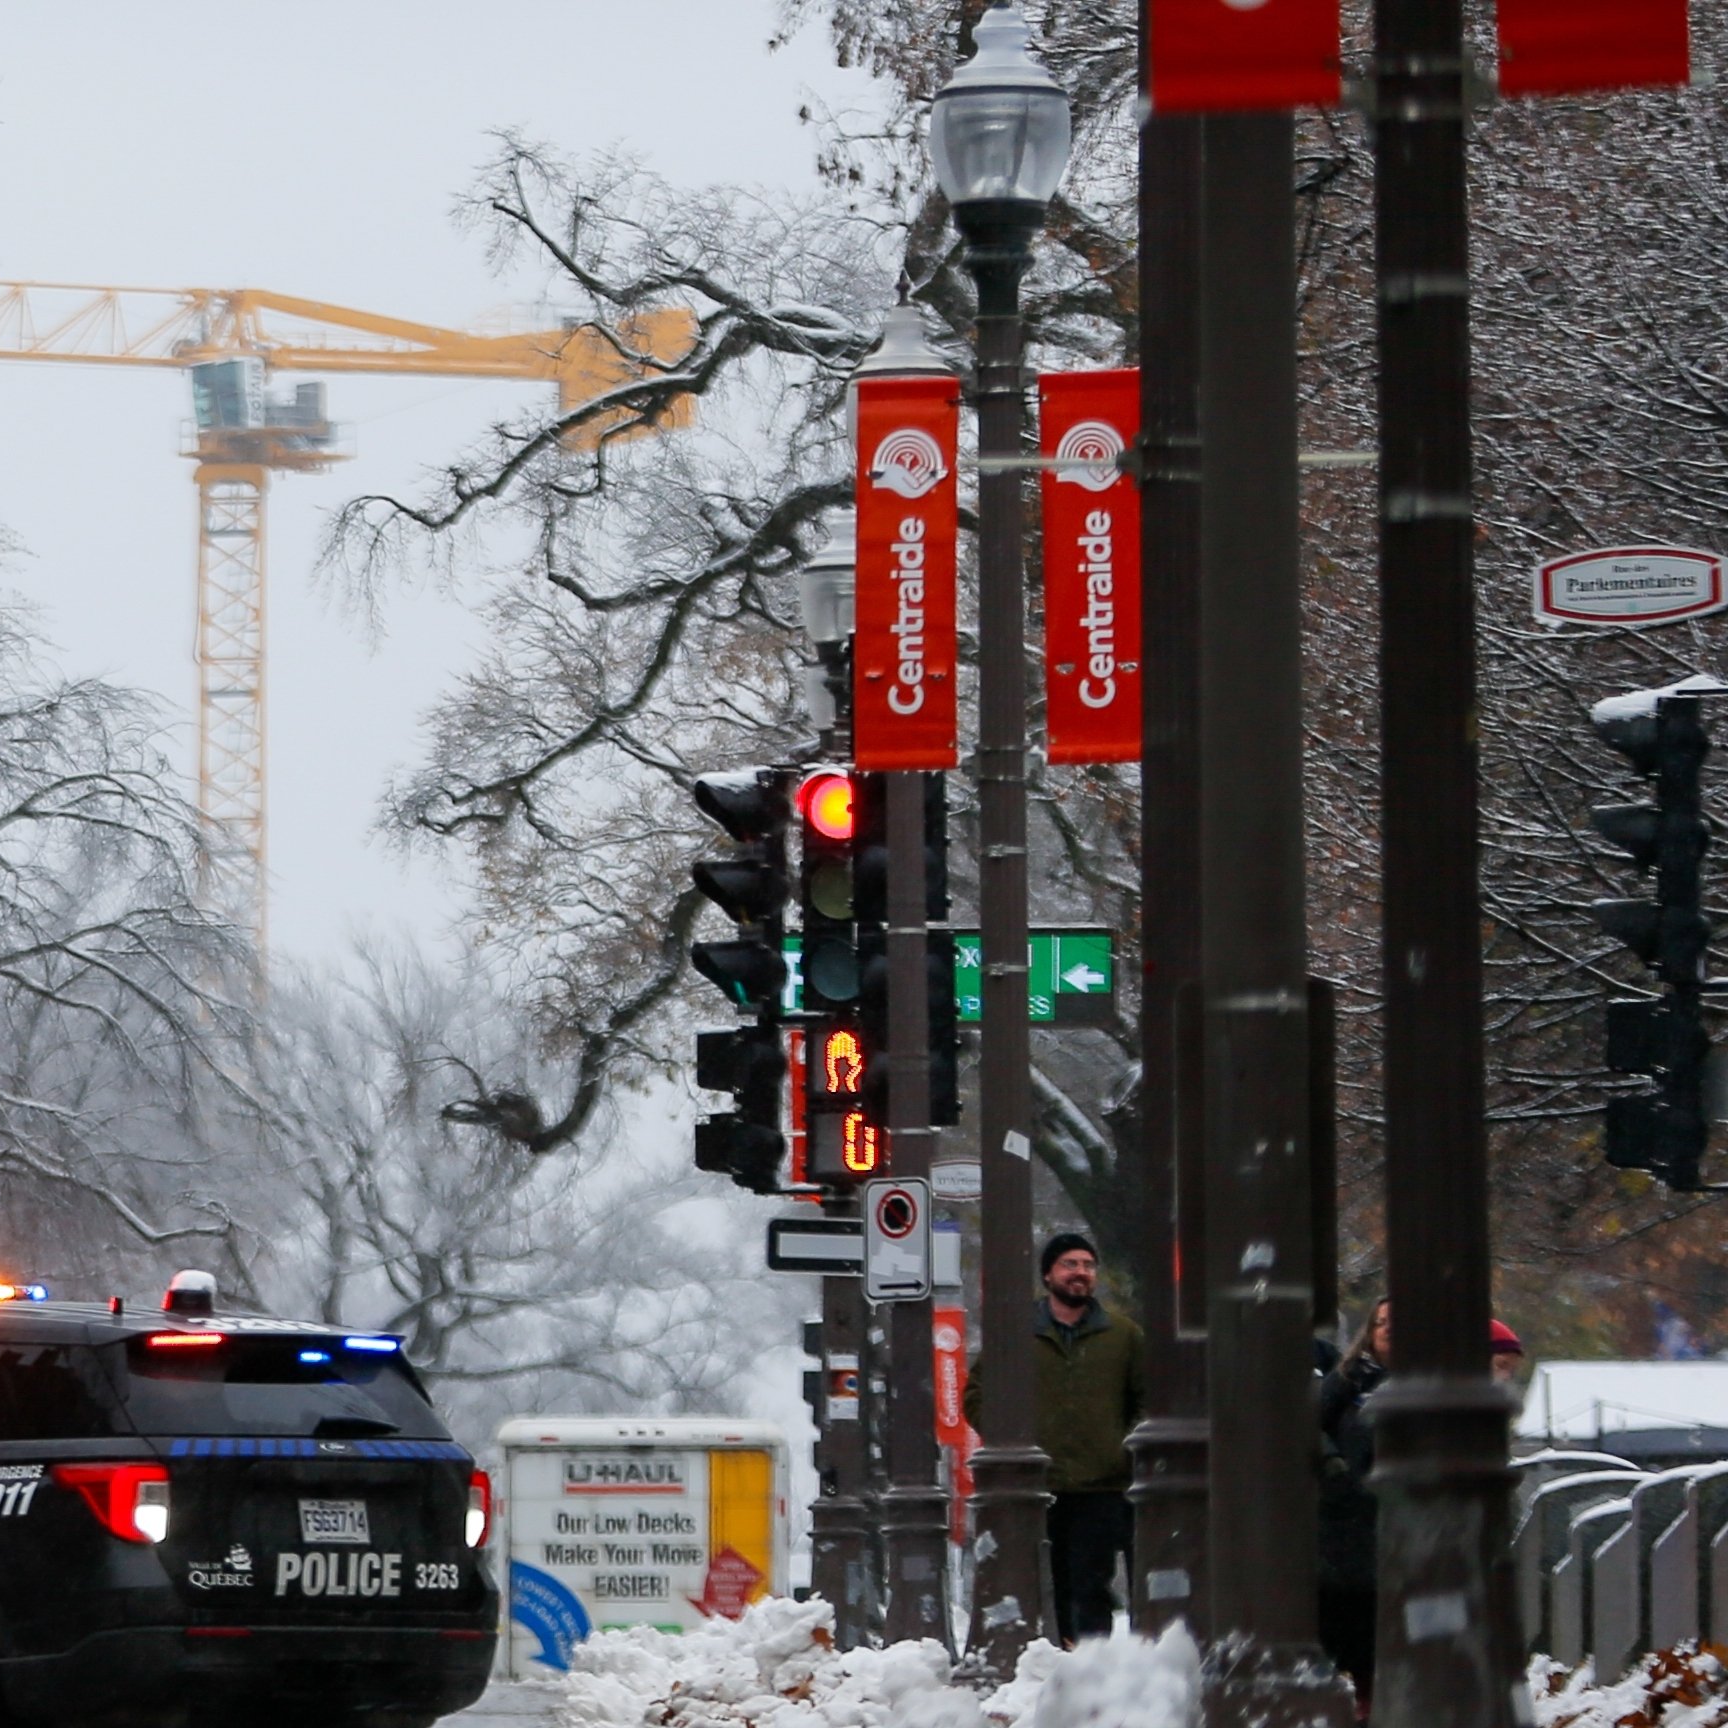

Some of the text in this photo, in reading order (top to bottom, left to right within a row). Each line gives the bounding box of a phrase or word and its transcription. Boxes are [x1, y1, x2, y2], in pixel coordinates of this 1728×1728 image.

[1566, 573, 1697, 593] Parlementaires
[887, 516, 926, 716] Centraide
[1077, 510, 1116, 709] Centraide
[568, 1463, 684, 1483] U-HAUL
[557, 1512, 696, 1535] Our Low Decks
[544, 1543, 705, 1566] Make Your Move
[274, 1552, 402, 1597] POLICE
[415, 1563, 460, 1590] 3263
[595, 1575, 670, 1599] EASIER!
